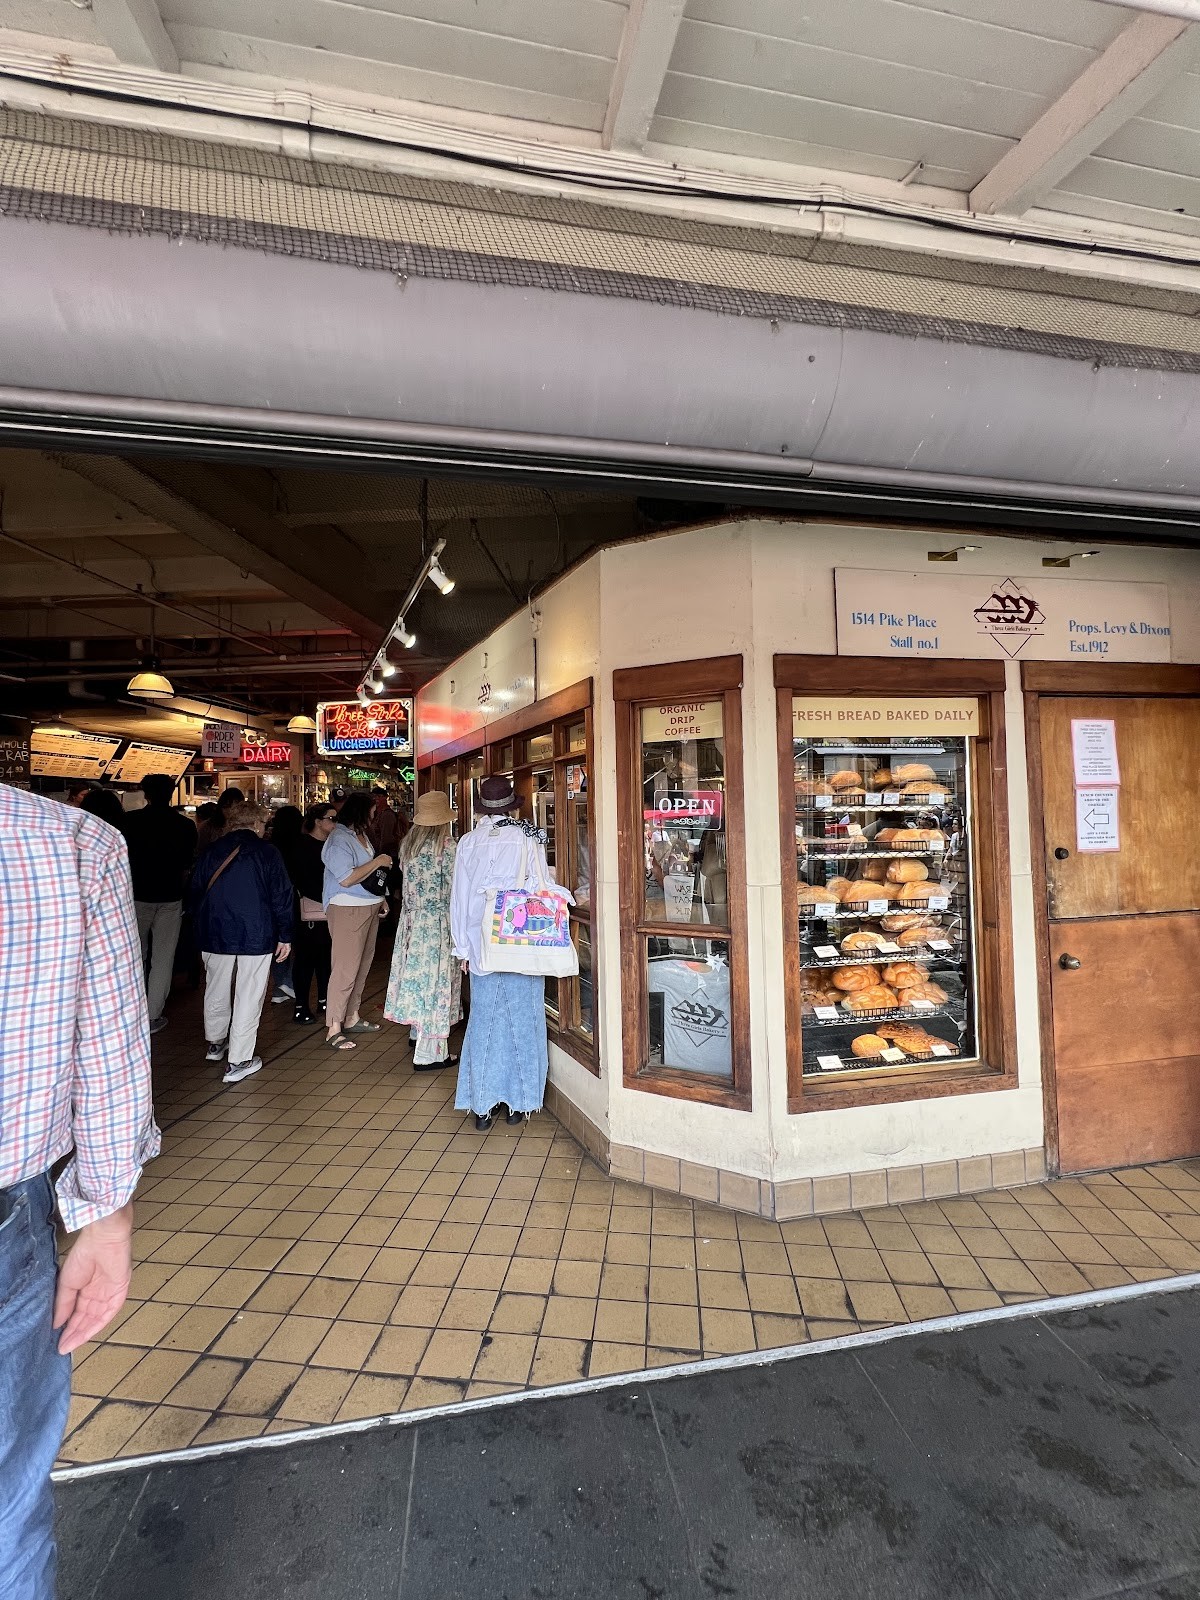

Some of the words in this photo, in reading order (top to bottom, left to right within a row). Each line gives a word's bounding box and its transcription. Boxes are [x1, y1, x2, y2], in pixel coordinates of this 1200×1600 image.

[851, 612, 875, 625] 1514
[879, 613, 903, 627] Pike
[907, 614, 937, 628] Place
[1069, 620, 1101, 635] Props.
[1104, 622, 1127, 634] Levy
[1129, 622, 1138, 633] &
[1140, 623, 1171, 636] Dixon
[890, 635, 913, 649] Stall
[917, 637, 938, 649] no.1
[326, 705, 364, 723] Three
[366, 703, 407, 720] Girls
[659, 703, 706, 715] ORGANIC
[837, 710, 881, 721] BREAD
[886, 710, 929, 721] BAKED
[934, 710, 974, 721] DAILY
[670, 715, 695, 725] DRIP
[335, 721, 390, 739] Bakery
[664, 726, 701, 736] COFFEE
[243, 746, 291, 762] DAIRY
[658, 797, 716, 816] OPEN
